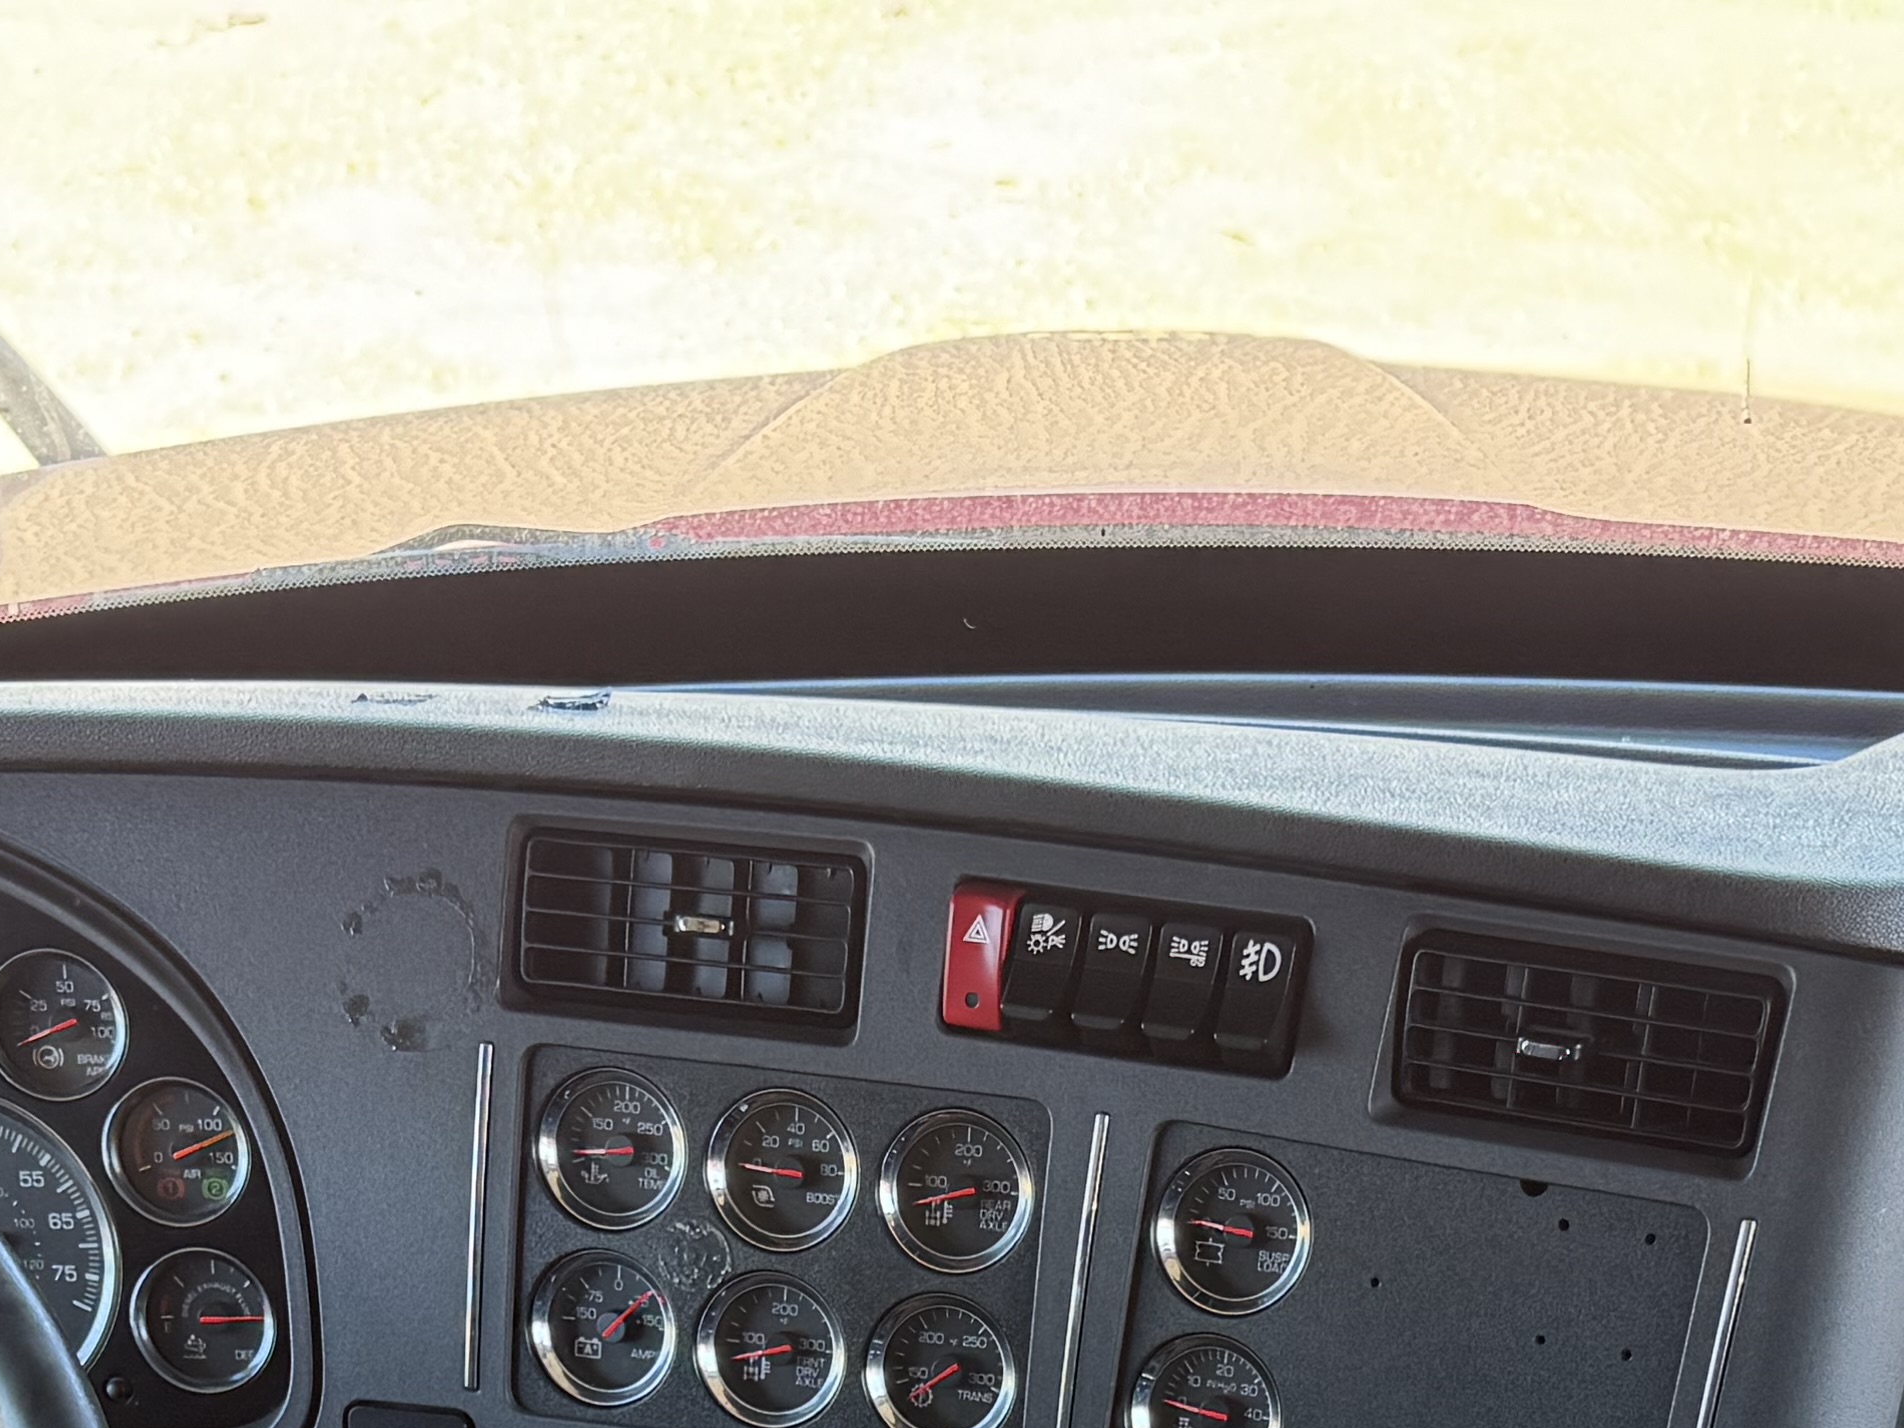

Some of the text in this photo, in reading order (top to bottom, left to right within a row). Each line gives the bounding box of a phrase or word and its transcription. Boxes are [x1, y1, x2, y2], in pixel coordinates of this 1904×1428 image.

[54, 981, 74, 993] 50
[30, 1000, 48, 1012] 25
[84, 1000, 102, 1012] 75
[613, 1100, 641, 1115] 200
[197, 1119, 223, 1131] 100
[592, 1117, 614, 1132] 150
[637, 1121, 664, 1137] 250
[786, 1122, 806, 1135] 40
[761, 1134, 781, 1149] 20
[811, 1138, 831, 1153] 60
[154, 1152, 163, 1164] 0
[209, 1152, 234, 1164] 150
[954, 1143, 984, 1158] 200
[644, 1152, 669, 1166] 300
[183, 1169, 201, 1180] AIR
[820, 1163, 839, 1177] 80
[18, 1171, 45, 1187] 55
[925, 1173, 949, 1189] 100
[982, 1180, 1011, 1194] 300
[1217, 1186, 1237, 1202] 50
[980, 1199, 1012, 1211] REAR
[1256, 1192, 1281, 1208] 100
[48, 1213, 75, 1229] 65
[979, 1209, 1004, 1221] DRV
[1265, 1225, 1290, 1240] 150
[1258, 1249, 1290, 1262] SUSP
[52, 1265, 78, 1281] 75
[612, 1278, 625, 1292] 0
[770, 1301, 799, 1317] 200
[742, 1331, 767, 1346] 100
[799, 1337, 826, 1352] 300
[918, 1331, 945, 1346] 200
[962, 1334, 988, 1350] 250
[795, 1366, 819, 1379] DRV
[1215, 1362, 1235, 1378] 20
[969, 1372, 996, 1387] 300
[1186, 1374, 1202, 1389] 10
[956, 1389, 994, 1405] TRANS
[1239, 1383, 1259, 1398] 30
[1243, 1406, 1264, 1422] 40
